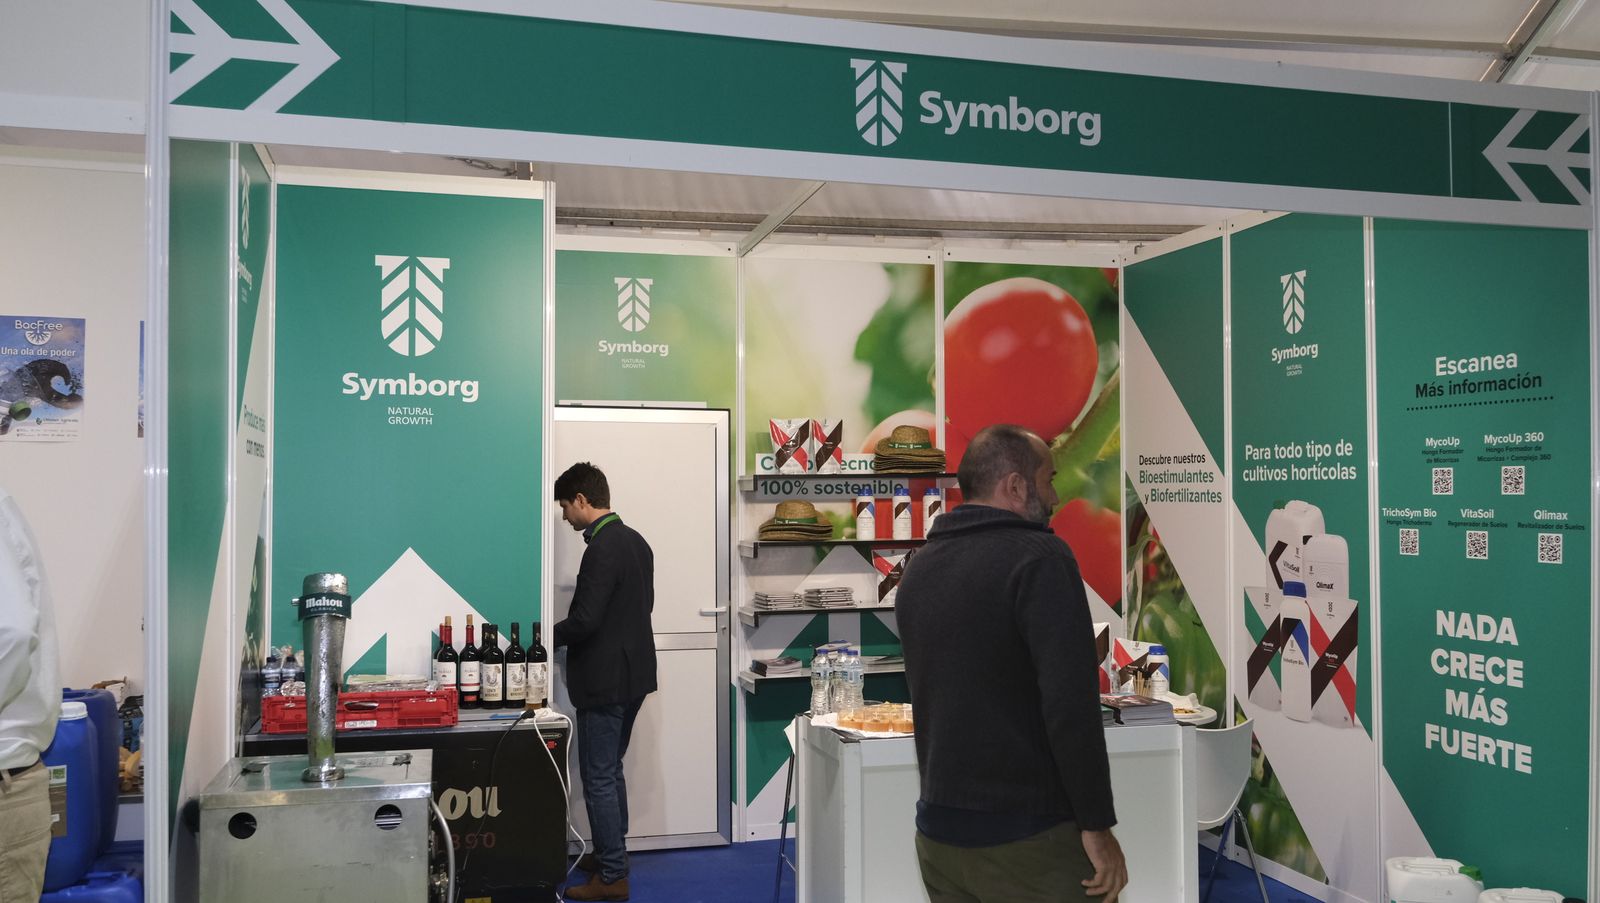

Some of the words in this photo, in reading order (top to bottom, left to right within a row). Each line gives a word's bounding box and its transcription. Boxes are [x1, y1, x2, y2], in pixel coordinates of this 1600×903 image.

[919, 90, 1102, 146] Symborg
[15, 319, 64, 331] BacFree
[1, 347, 18, 355] Una
[20, 347, 34, 356] ola
[36, 348, 48, 356] de
[50, 349, 76, 357] poder
[597, 340, 669, 357] Symborg
[1271, 343, 1319, 364] Symborg
[1435, 353, 1518, 377] Escanea
[341, 372, 479, 403] Symborg
[1415, 382, 1444, 399] Más
[1448, 372, 1542, 396] información
[387, 407, 434, 416] NATURAL
[388, 416, 433, 425] GROWTH
[1425, 437, 1460, 448] MycoUp
[1484, 433, 1523, 446] MycoUp
[1524, 431, 1545, 442] 360
[1245, 444, 1271, 461] Para
[1274, 442, 1301, 459] todo
[1305, 440, 1332, 461] tipo
[1335, 439, 1353, 456] de
[1138, 455, 1172, 466] Descubre
[1173, 453, 1206, 465] nuestros
[1139, 469, 1214, 484] Bioestimulantes
[1243, 466, 1288, 482] cultivos
[1291, 463, 1357, 481] hortícolas
[760, 480, 808, 495] 100%
[1145, 494, 1149, 504] y
[1150, 488, 1222, 503] Biofertilizantes
[1382, 508, 1421, 519] TrichoSym
[1423, 508, 1437, 517] Bio
[1460, 509, 1494, 519] VitaSoil
[1534, 509, 1568, 520] Qlimax
[305, 596, 343, 608] Mahou
[1436, 609, 1519, 646] NADA
[1430, 648, 1524, 689] CRECE
[1445, 688, 1509, 726] MÁS
[1425, 722, 1532, 775] FUERTE
